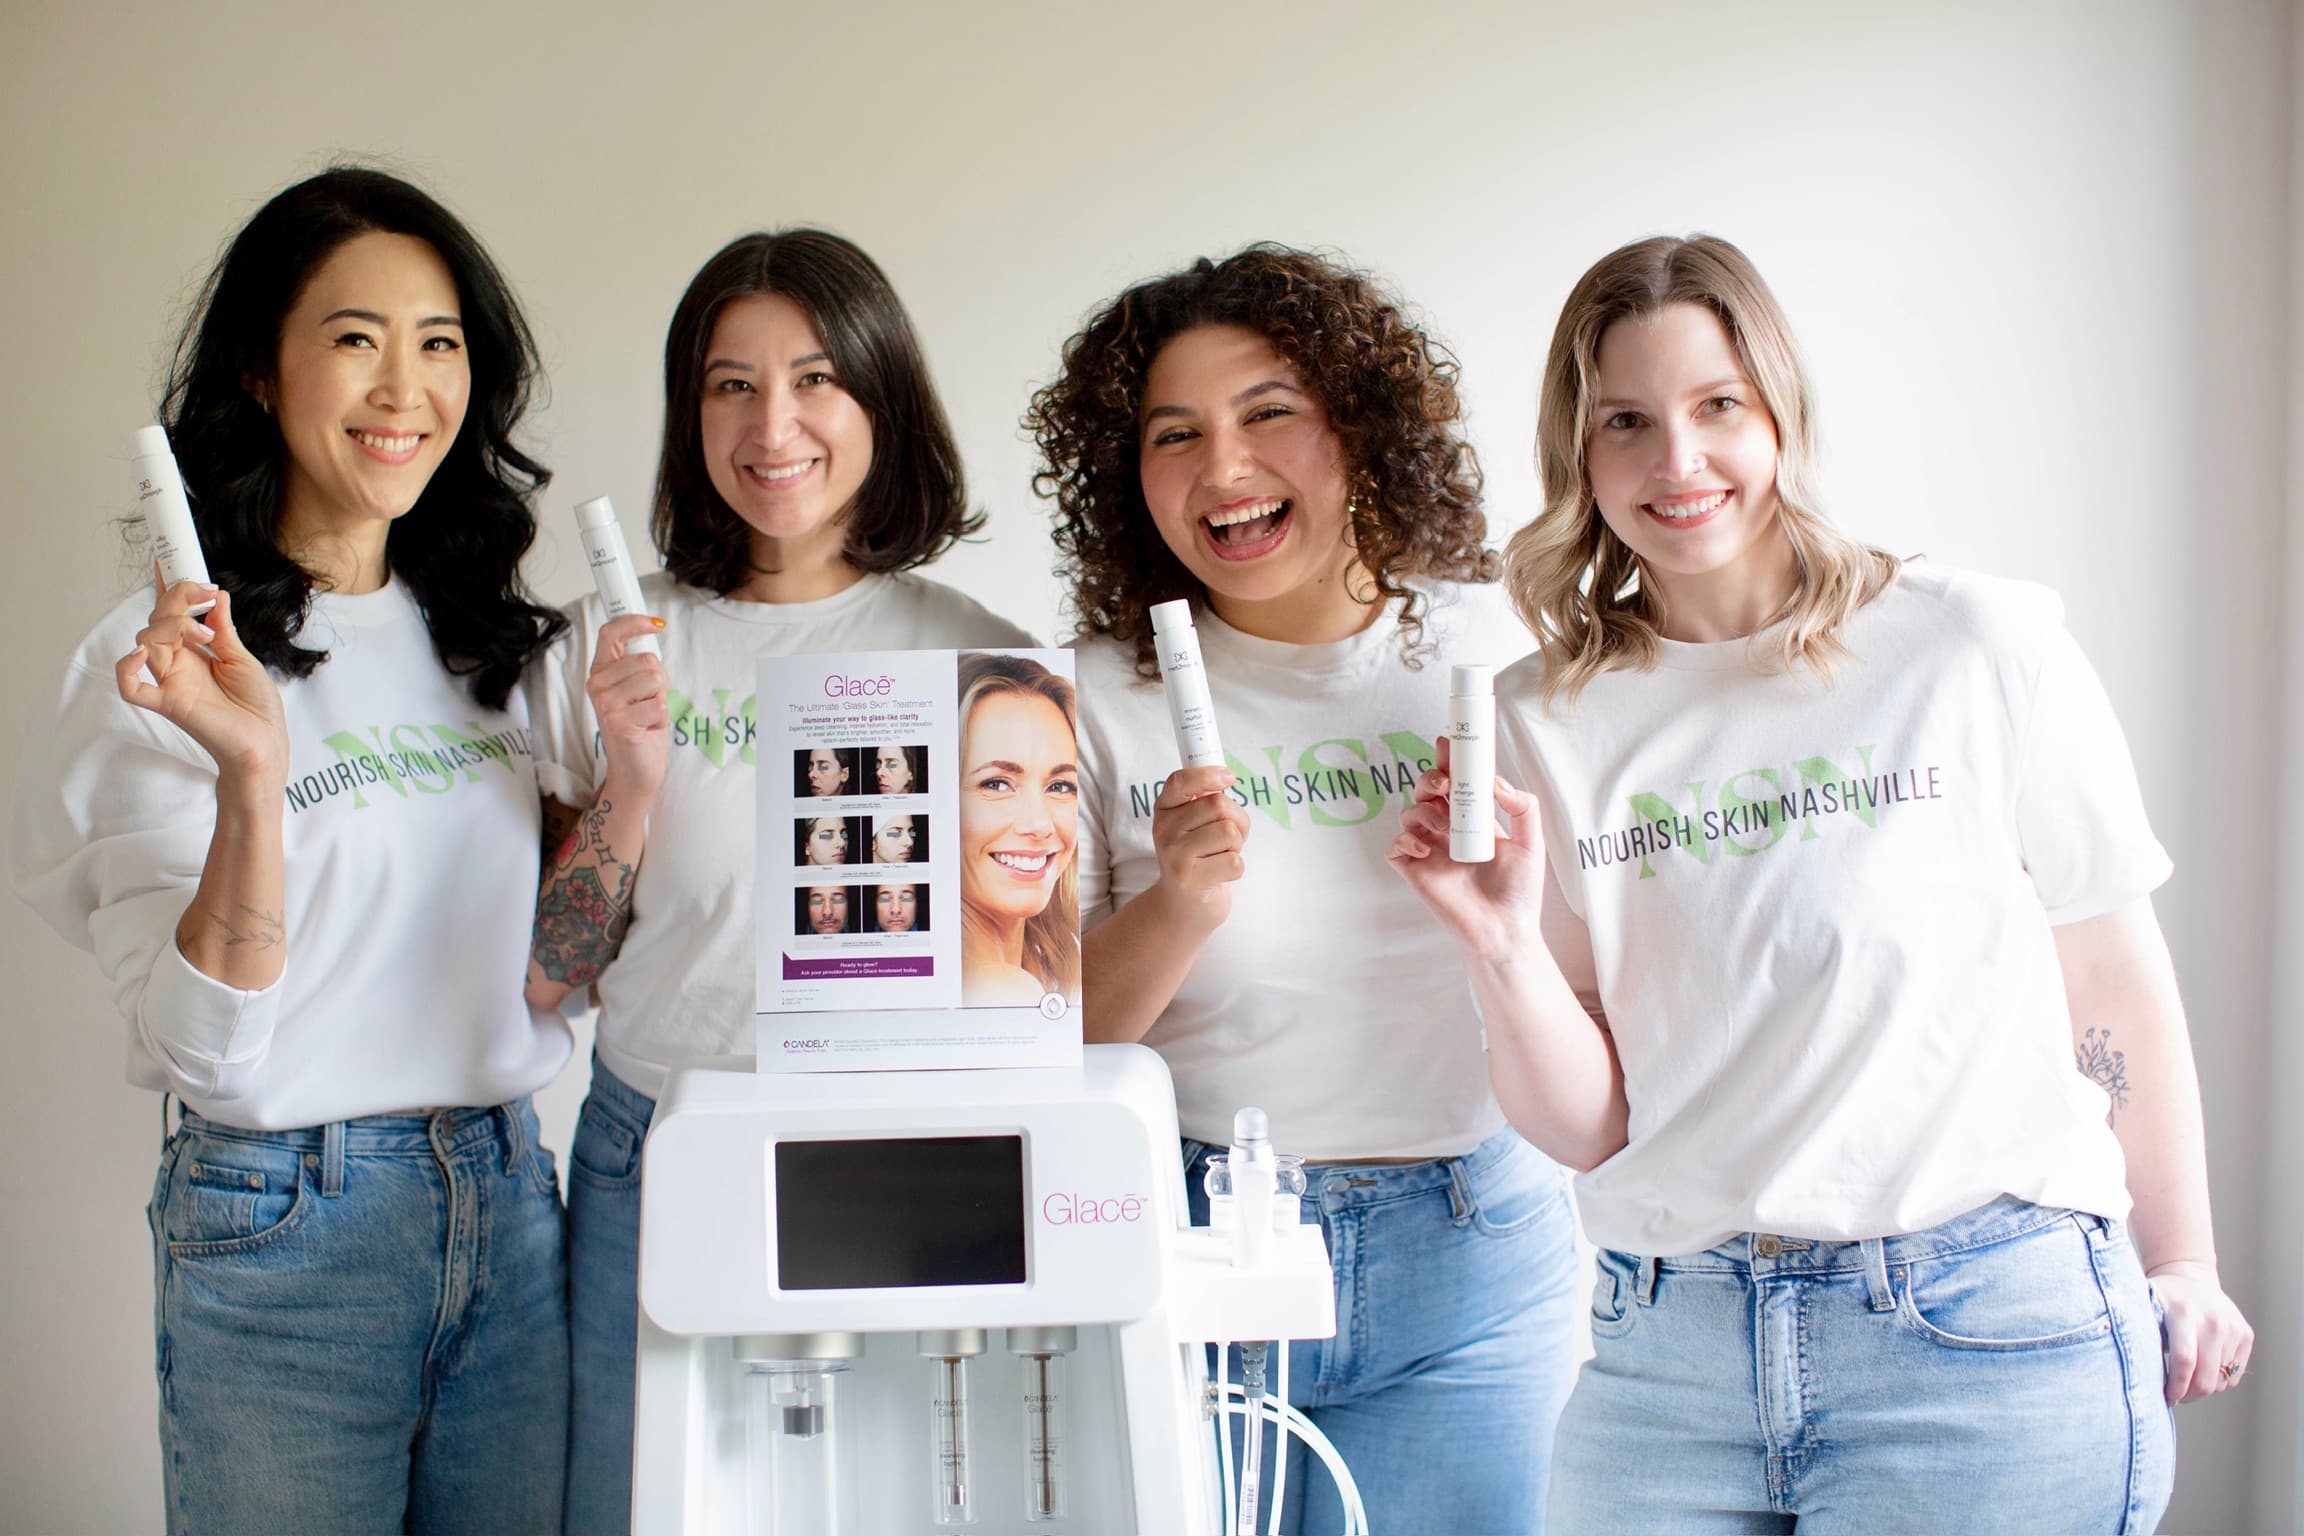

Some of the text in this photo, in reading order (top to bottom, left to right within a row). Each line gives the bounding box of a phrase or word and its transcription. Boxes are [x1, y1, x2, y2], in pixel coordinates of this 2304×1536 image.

[788, 704, 805, 713] The
[806, 703, 840, 712] Ultimate
[892, 699, 933, 709] Treatment
[833, 716, 846, 724] your
[861, 714, 868, 722] to
[868, 714, 899, 722] glass-like
[899, 713, 919, 721] clarity
[724, 716, 756, 744] SK
[285, 728, 532, 813] NOURISH SKIN NASHVILL
[1284, 769, 1360, 804] SKIN
[1578, 766, 1942, 869] NOURISH SKIN NASHVILLE
[1626, 744, 1877, 880] NSN
